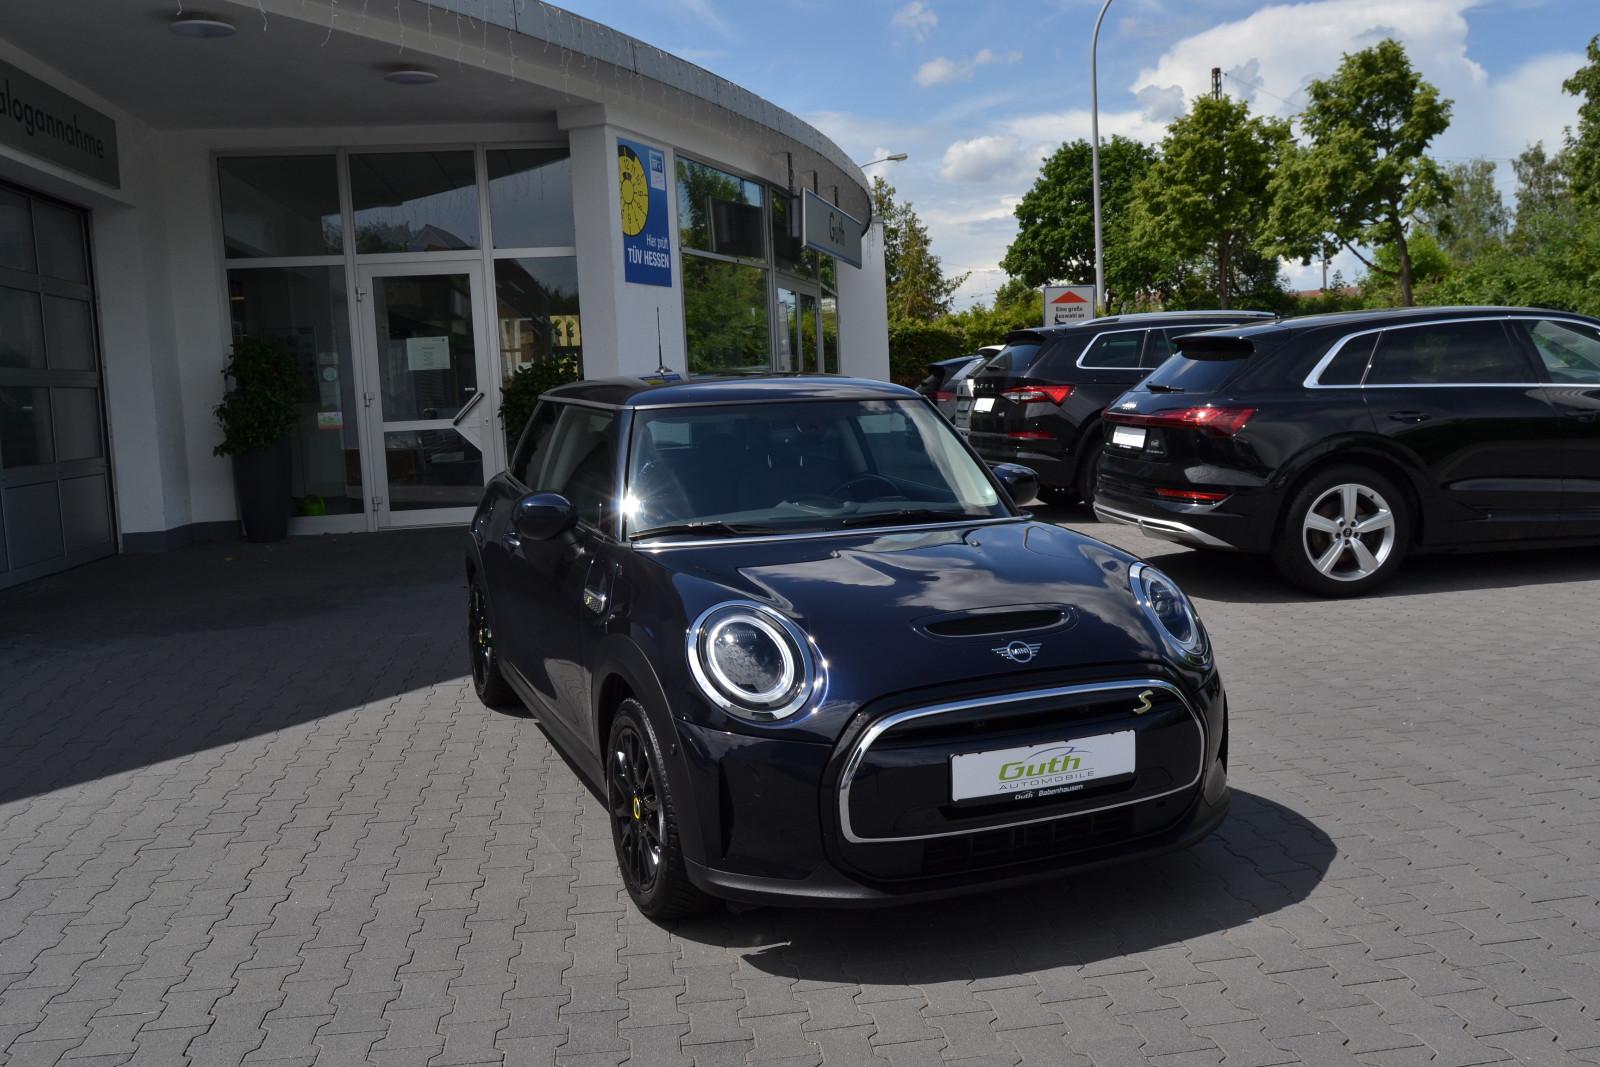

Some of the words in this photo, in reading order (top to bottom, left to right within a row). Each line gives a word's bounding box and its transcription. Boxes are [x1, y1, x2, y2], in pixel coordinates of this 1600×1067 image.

[646, 233, 657, 247] Hier
[628, 245, 642, 264] TÜV
[643, 249, 670, 269] HESSEN
[1011, 647, 1030, 656] MINI
[1133, 689, 1154, 715] S
[998, 755, 1081, 781] Guth
[999, 770, 1095, 790] AUTOMOBILE
[1038, 784, 1084, 797] Babenhausen
